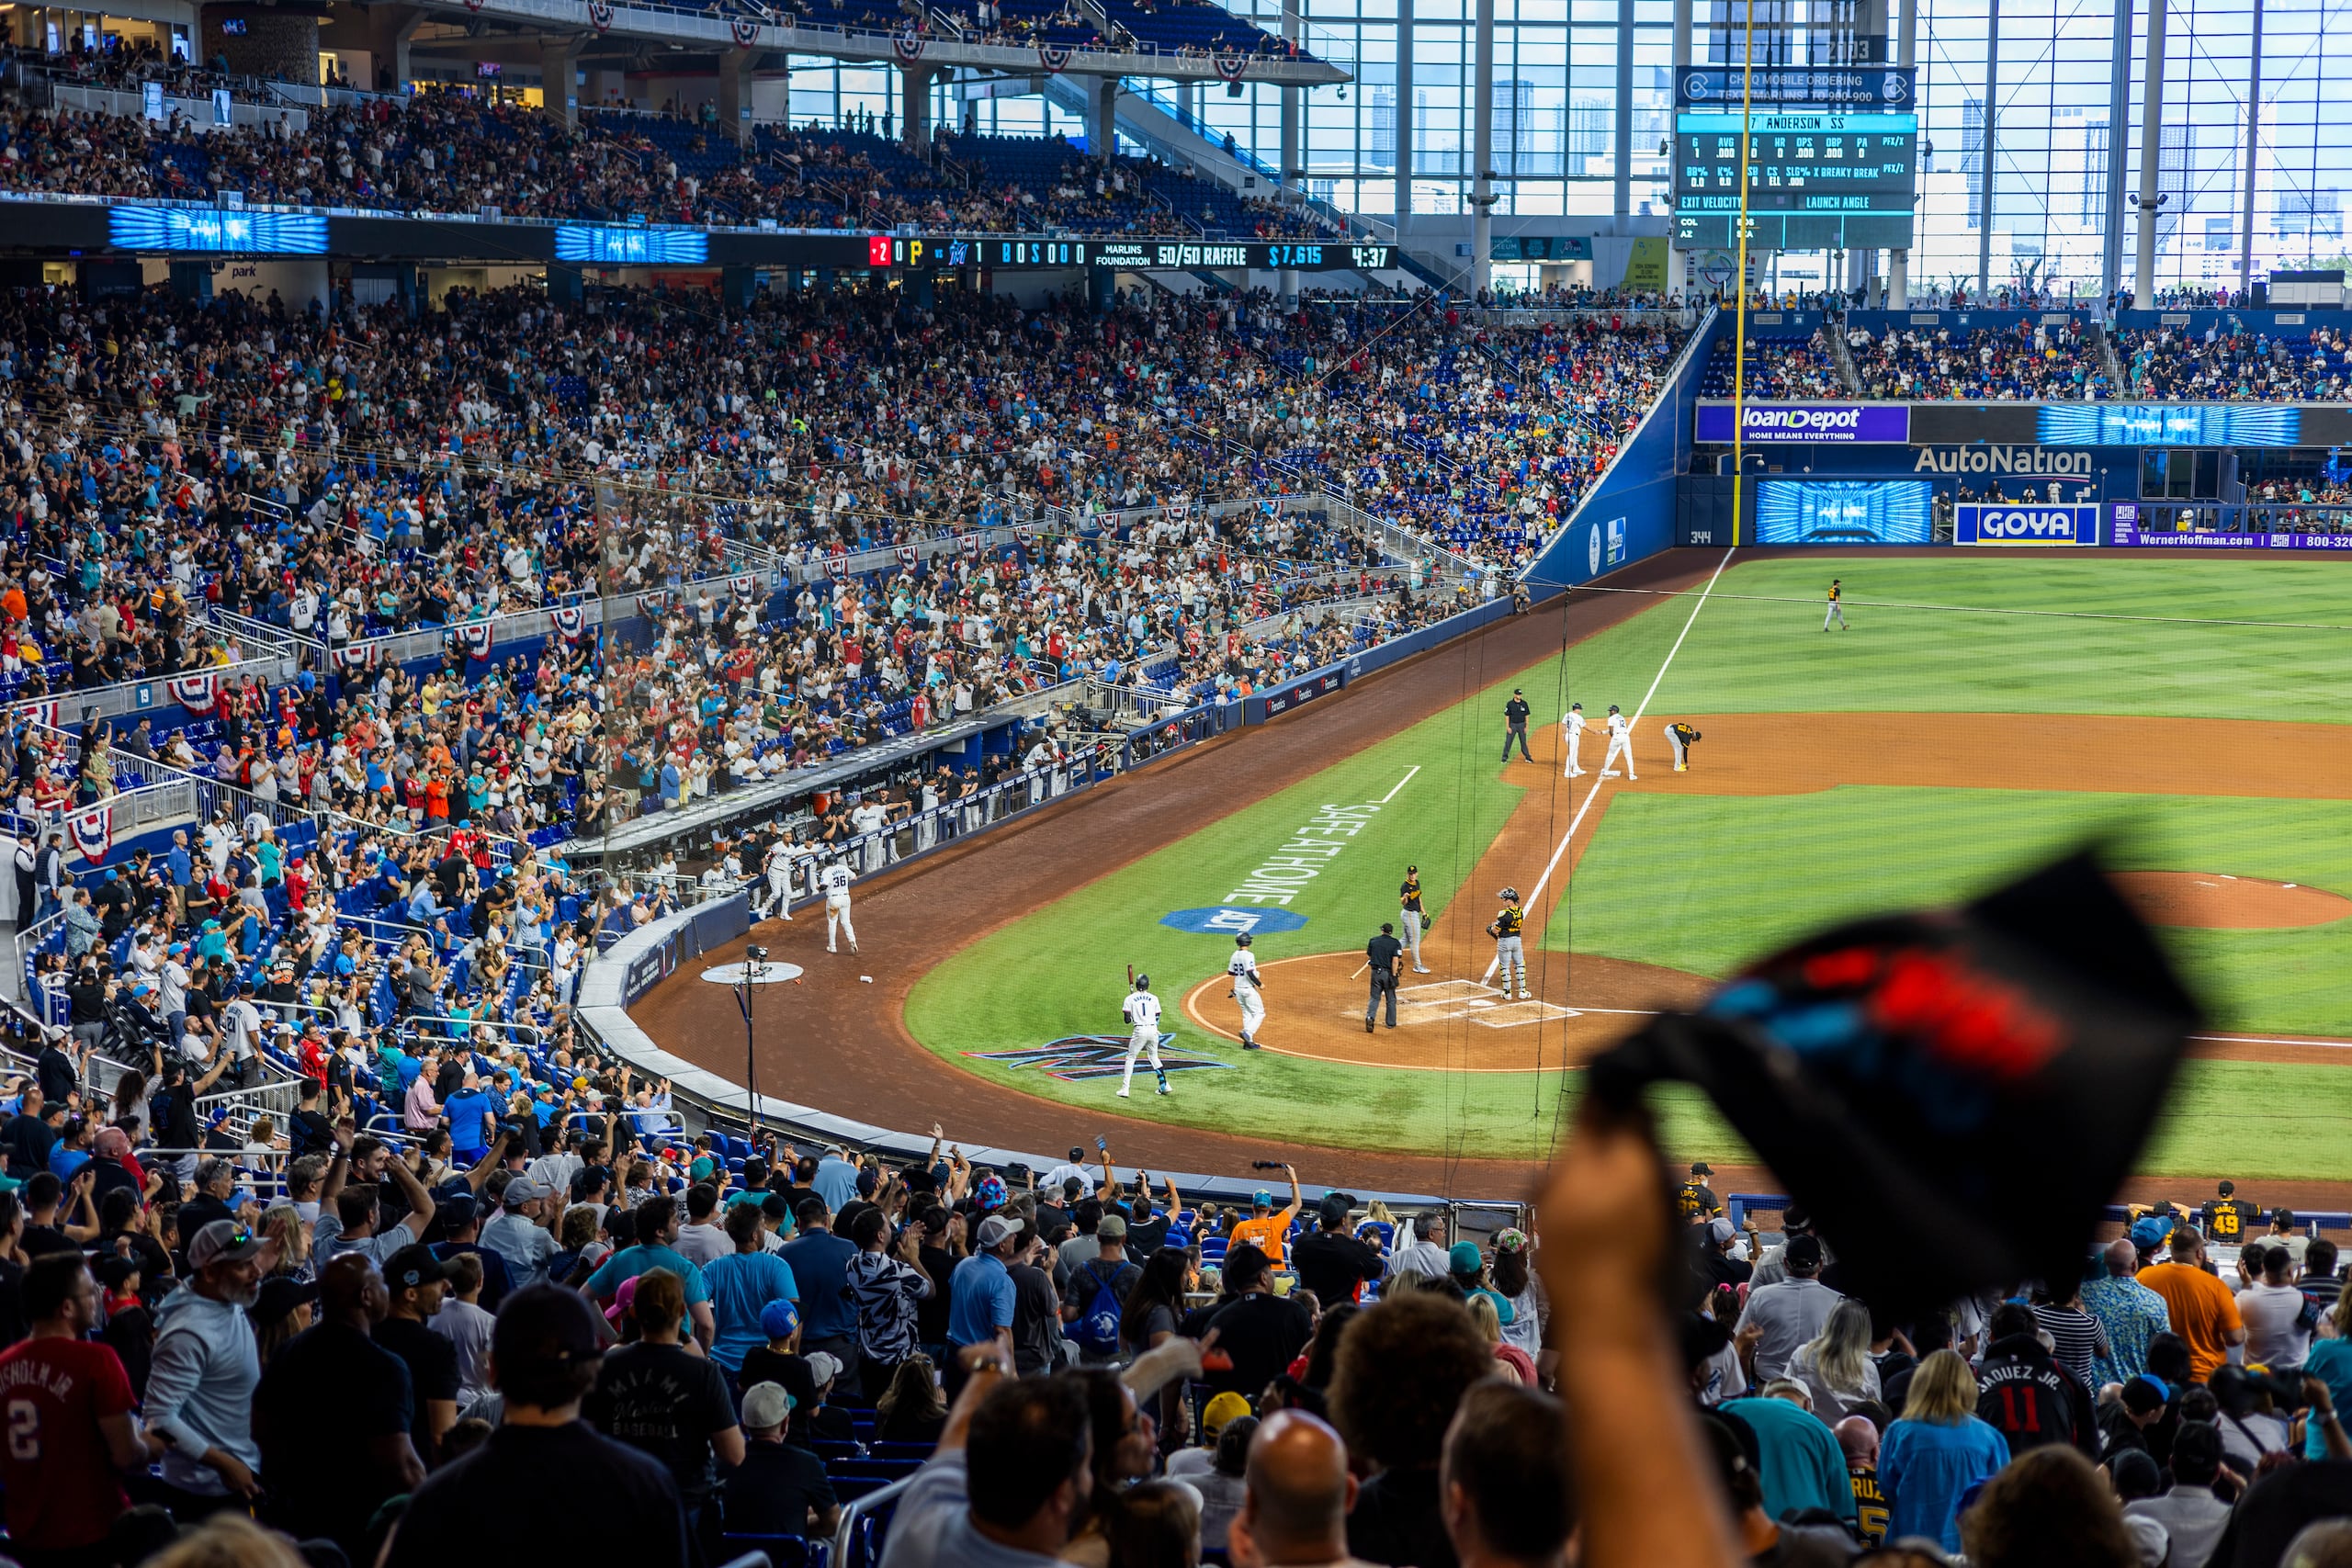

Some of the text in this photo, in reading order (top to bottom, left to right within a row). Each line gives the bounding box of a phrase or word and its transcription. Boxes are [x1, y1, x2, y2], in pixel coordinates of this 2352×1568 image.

[1826, 40, 1870, 60] 2003
[1729, 74, 1863, 86] CHQ MOBILE ORDERING
[1719, 90, 1746, 101] TEXT
[1811, 90, 1826, 101] TO
[1827, 91, 1872, 103] 900-900
[1750, 118, 1845, 130] 7 ANDERSON SS
[1718, 138, 1735, 148] AVG
[1751, 138, 1758, 148] R
[1774, 138, 1786, 148] HR
[1796, 138, 1813, 148] OPS
[1826, 138, 1842, 148] OBP
[1857, 138, 1868, 148] PA
[1716, 148, 1736, 159] .000
[1795, 148, 1815, 159] .000
[1824, 148, 1843, 159] .000
[1687, 166, 1708, 177] BB%
[1717, 166, 1734, 177] K%
[1747, 166, 1758, 176] SB
[1767, 166, 1778, 177] CS
[1786, 166, 1811, 177] SLG%
[1853, 167, 1879, 178] BREAK
[1681, 197, 1743, 209] EXIT VELOCITY
[1806, 197, 1870, 209] LAUNCH ANGLE
[1680, 219, 1698, 227] COL
[1680, 231, 1693, 239] AZ
[1736, 231, 1754, 239] SA
[878, 242, 888, 263] 2
[895, 241, 903, 263] 0
[976, 243, 982, 263] 1
[1002, 243, 1012, 263] B
[1031, 243, 1040, 264] S
[1105, 245, 1142, 255] MARLINS
[1158, 244, 1201, 268] 50/50
[1203, 246, 1247, 266] RAFFLE
[1351, 246, 1388, 268] 4:37
[1096, 256, 1150, 266] FOUNDATION
[232, 265, 256, 280] park
[1742, 407, 1860, 432] loanDepot
[1748, 432, 1856, 441] HOME MEANS EVERYTHING
[1914, 445, 2093, 473] AutoNation
[1984, 512, 2072, 538] GOYA
[1690, 531, 1712, 545] 344
[2140, 533, 2254, 547] WernerHoffman.com
[140, 688, 149, 704] 19
[1271, 698, 1285, 714] Fanatics
[1222, 804, 1382, 905] SAFE AT HOME
[832, 875, 846, 888] 36
[1204, 909, 1262, 933] ADT
[1142, 1002, 1147, 1017] 1
[227, 1016, 236, 1032] 21
[1680, 1190, 1699, 1199] LOPEZ
[2214, 1206, 2238, 1214] HAINES
[2213, 1214, 2240, 1235] 49
[0, 1359, 74, 1404] ISHOLM JR.
[608, 1368, 690, 1403] MIAMI
[2037, 1371, 2061, 1391] JR.
[1999, 1385, 2041, 1433] 11
[8, 1399, 40, 1460] 2
[613, 1421, 679, 1438] BASEBALL
[1849, 1477, 1885, 1502] RUZ
